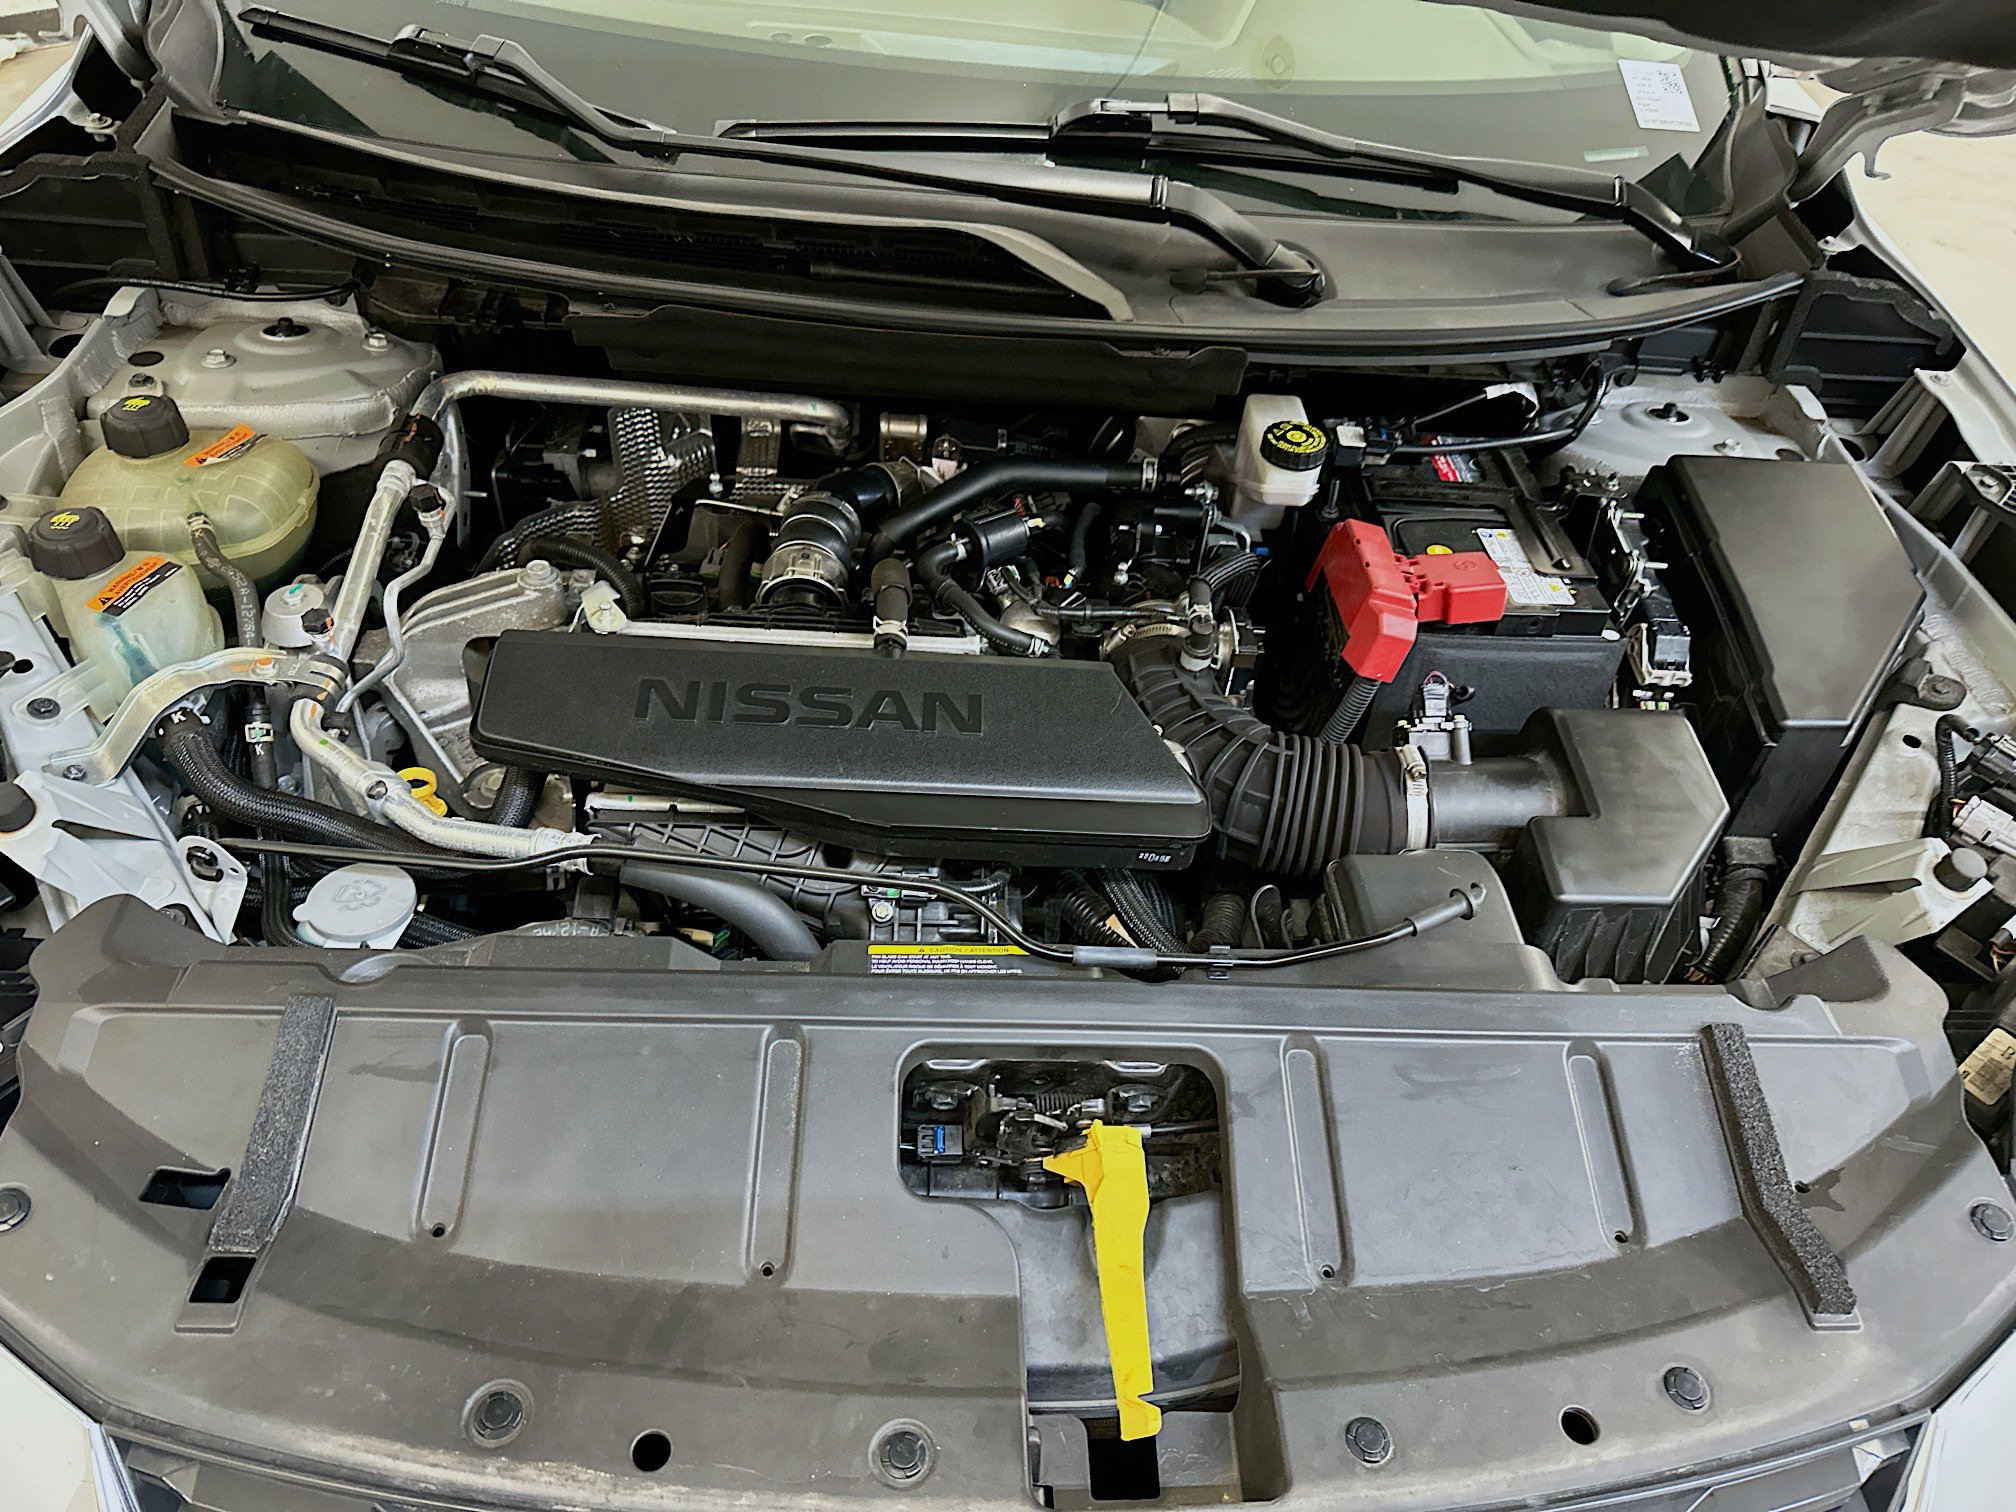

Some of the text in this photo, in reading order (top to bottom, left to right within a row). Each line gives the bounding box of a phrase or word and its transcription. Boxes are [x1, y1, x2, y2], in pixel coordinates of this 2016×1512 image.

[633, 678, 984, 736] NISSAN
[171, 711, 187, 724] K
[254, 743, 265, 756] K
